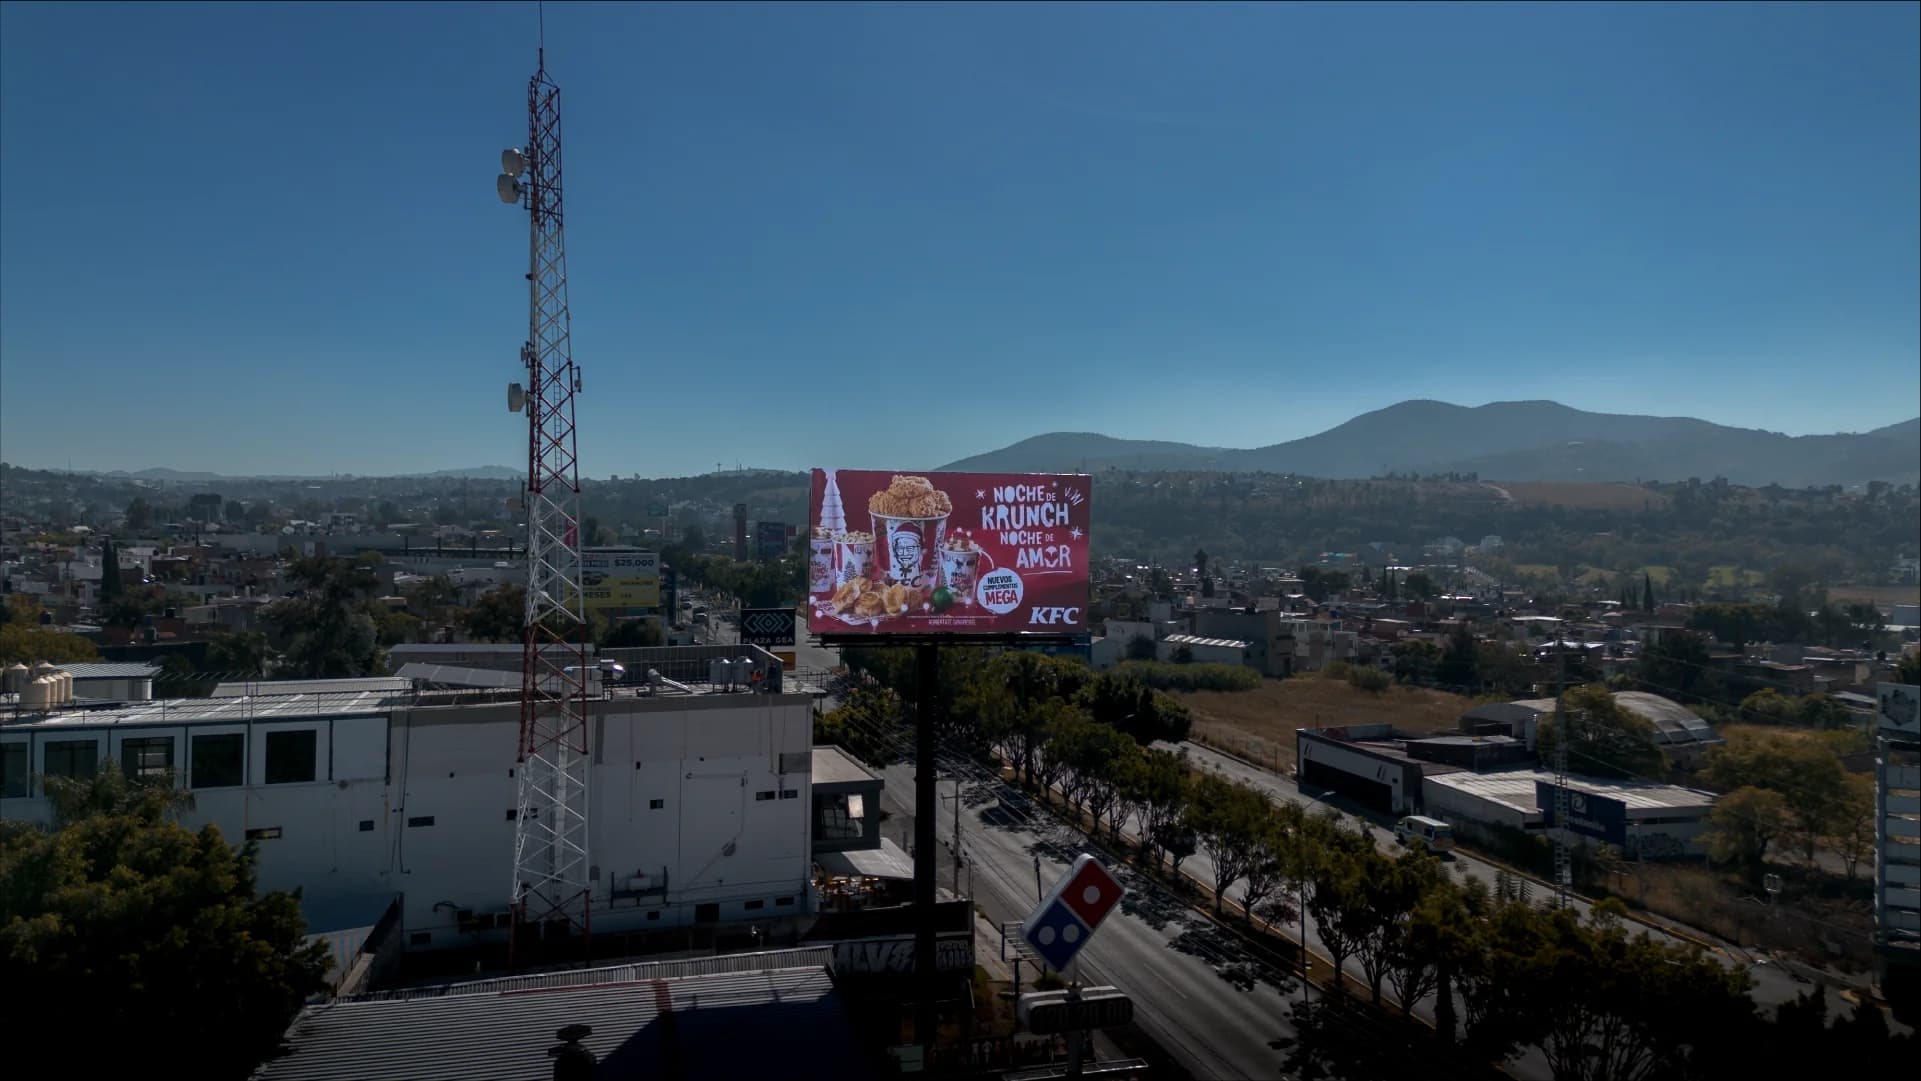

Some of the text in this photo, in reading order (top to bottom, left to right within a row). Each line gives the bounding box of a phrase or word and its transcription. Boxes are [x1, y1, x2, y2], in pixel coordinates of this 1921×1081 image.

[993, 484, 1057, 503] NOCHE DE
[982, 502, 1069, 530] KRUNCH
[1000, 531, 1054, 545] NOCHE DE
[614, 559, 654, 568] $25,000
[1016, 544, 1071, 568] AMOR
[987, 576, 1012, 584] NUEVOS
[985, 590, 1018, 605] MEGA
[1028, 607, 1079, 624] KFC
